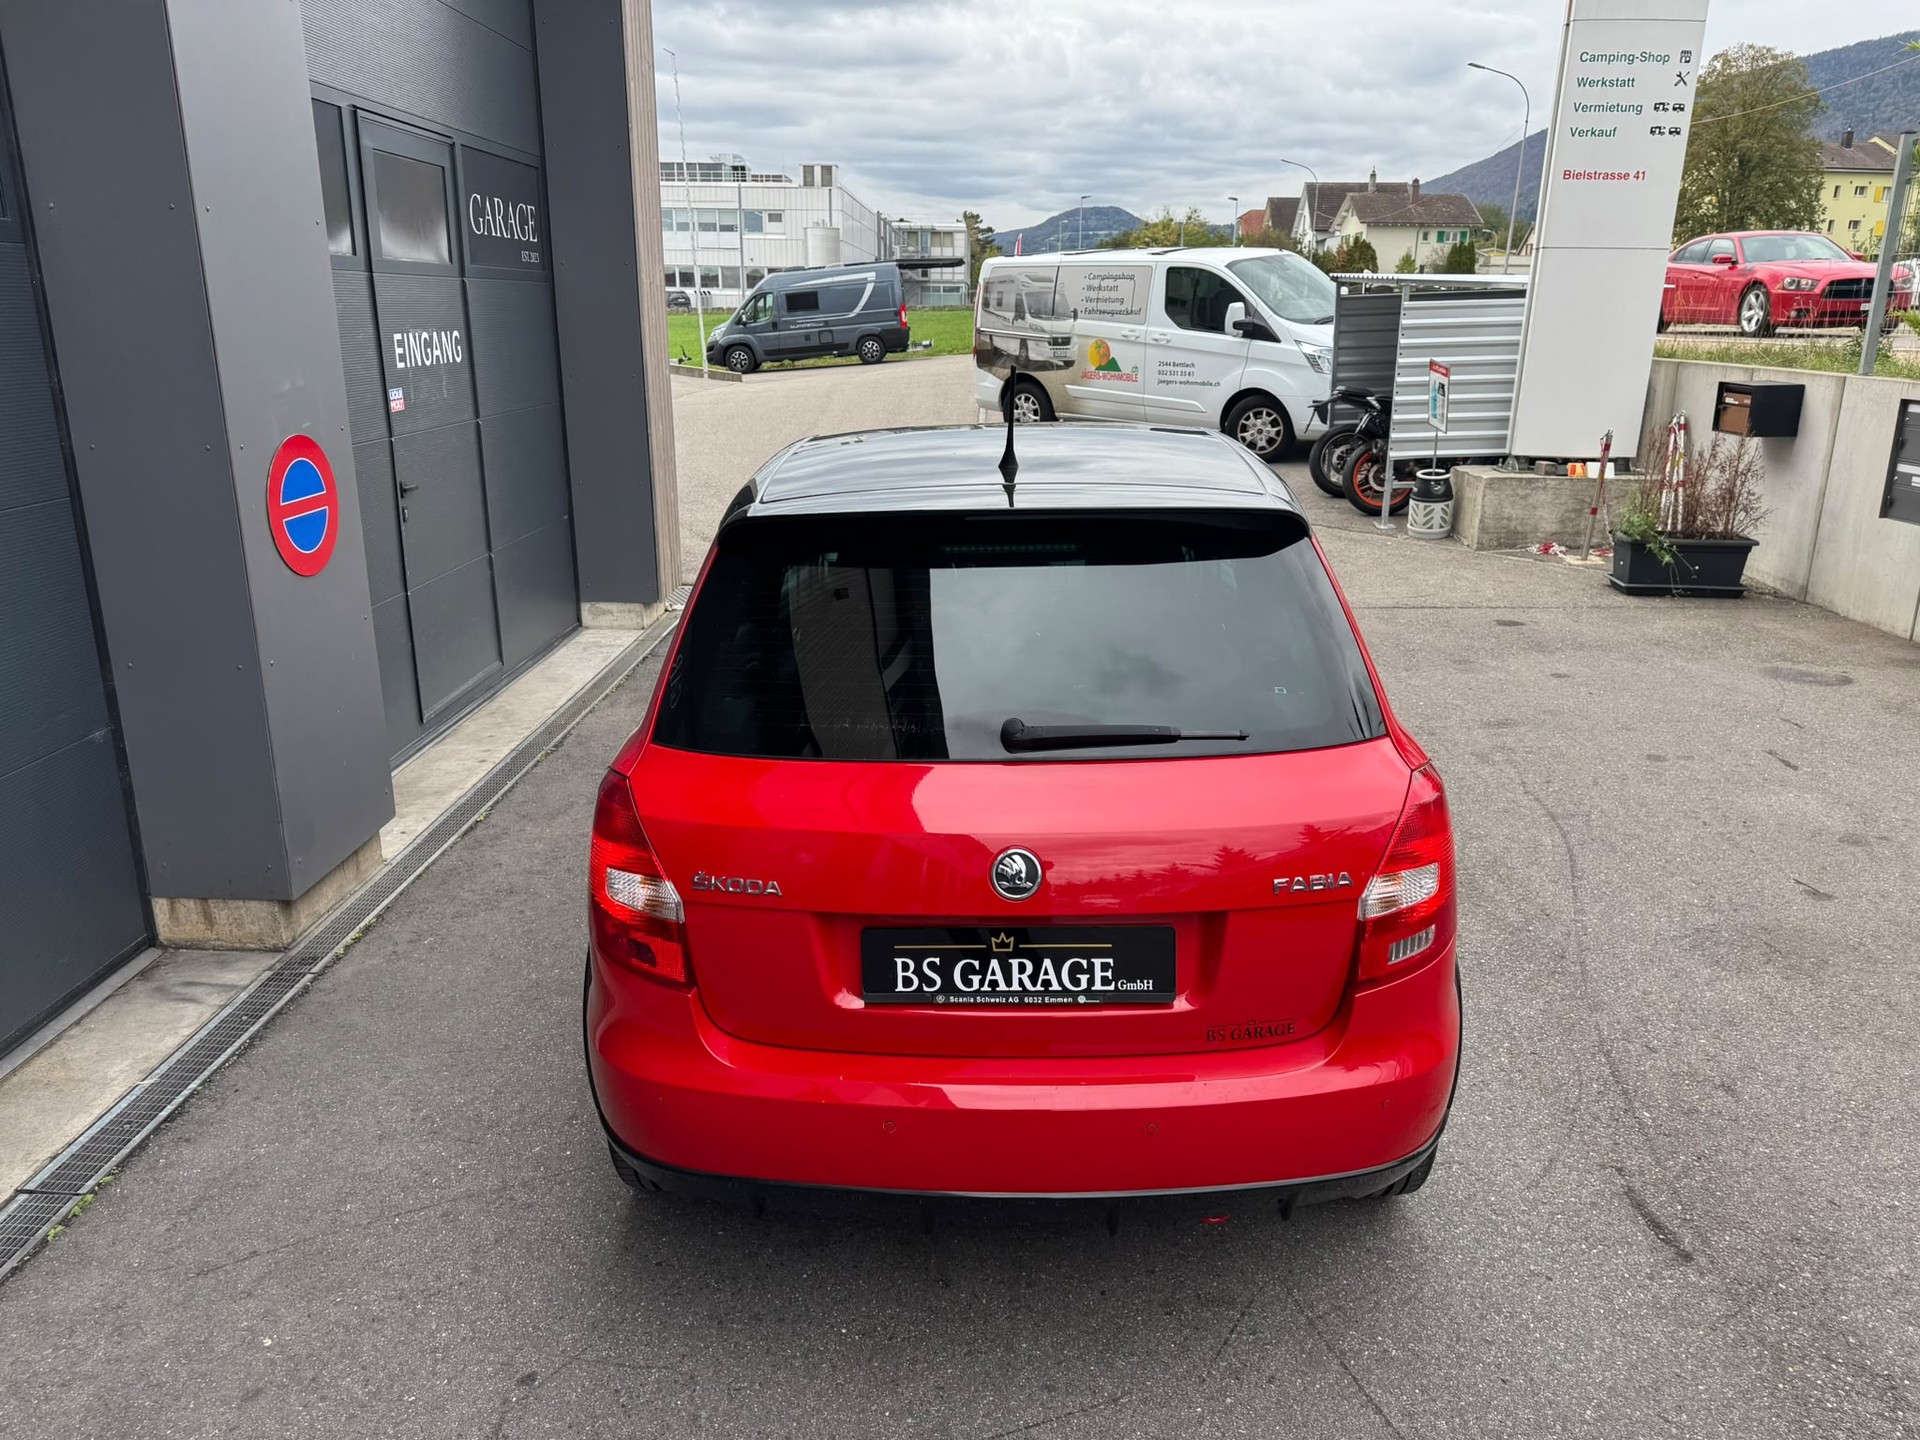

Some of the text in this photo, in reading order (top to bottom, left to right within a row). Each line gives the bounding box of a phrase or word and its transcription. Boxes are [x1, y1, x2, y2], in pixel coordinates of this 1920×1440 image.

[1579, 51, 1671, 65] Camping-Shop
[1576, 77, 1635, 88] Werkstatt
[1573, 102, 1643, 115] Vermietung
[1570, 126, 1617, 138] Verkauf
[1562, 170, 1647, 181] Bielstrasse 41
[469, 193, 538, 242] GARAGE
[1087, 272, 1136, 281] Campingshop
[1086, 284, 1119, 292] Werkstatt
[1084, 296, 1125, 305] Vermietung
[393, 330, 462, 369] EINGANG
[692, 870, 783, 896] ŠKODA
[1273, 871, 1354, 894] FABIA
[894, 957, 1154, 992] BS GARAGE GmbH
[1206, 1023, 1296, 1042] BS GARAGE
